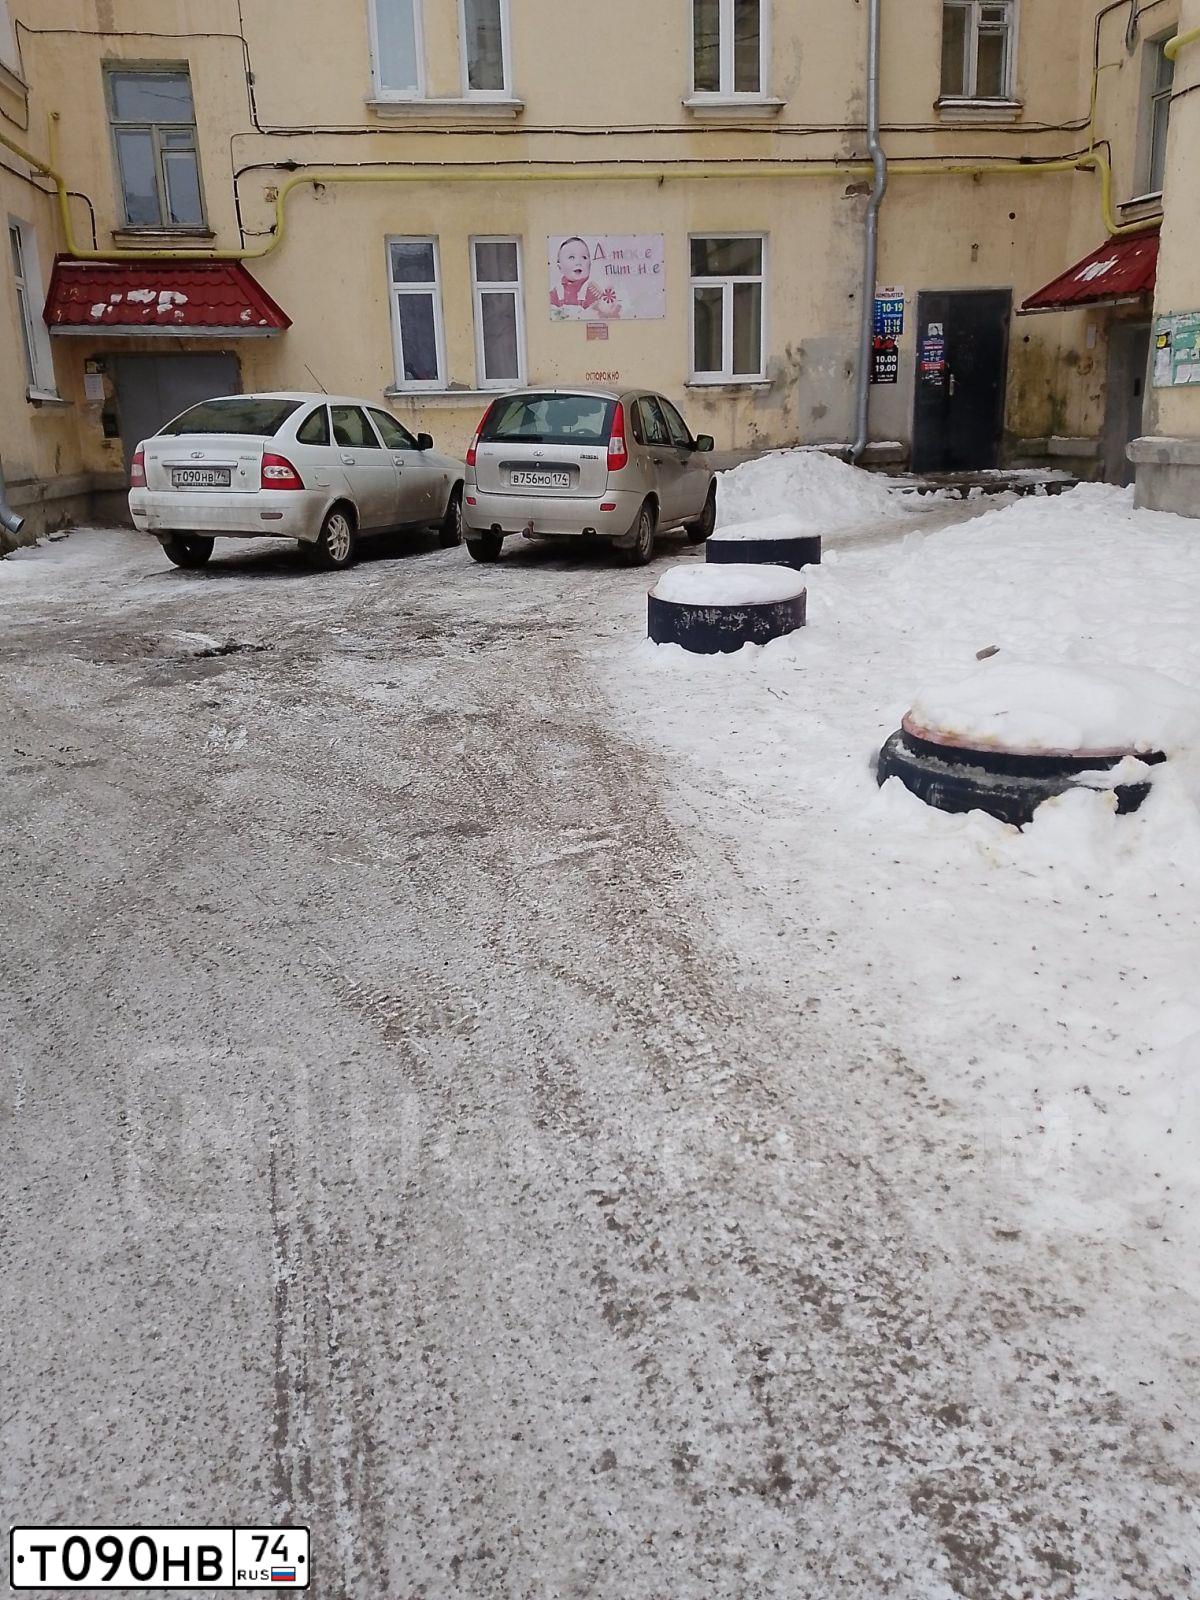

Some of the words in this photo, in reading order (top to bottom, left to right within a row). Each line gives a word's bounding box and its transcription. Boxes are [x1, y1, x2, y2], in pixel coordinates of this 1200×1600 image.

[882, 302, 903, 313] 10-19
[876, 355, 897, 363] 10.00
[875, 364, 897, 372] 19.00
[176, 470, 214, 482] Т090НВ
[216, 471, 226, 480] 74
[513, 472, 551, 484] В756МО
[552, 473, 568, 483] 174
